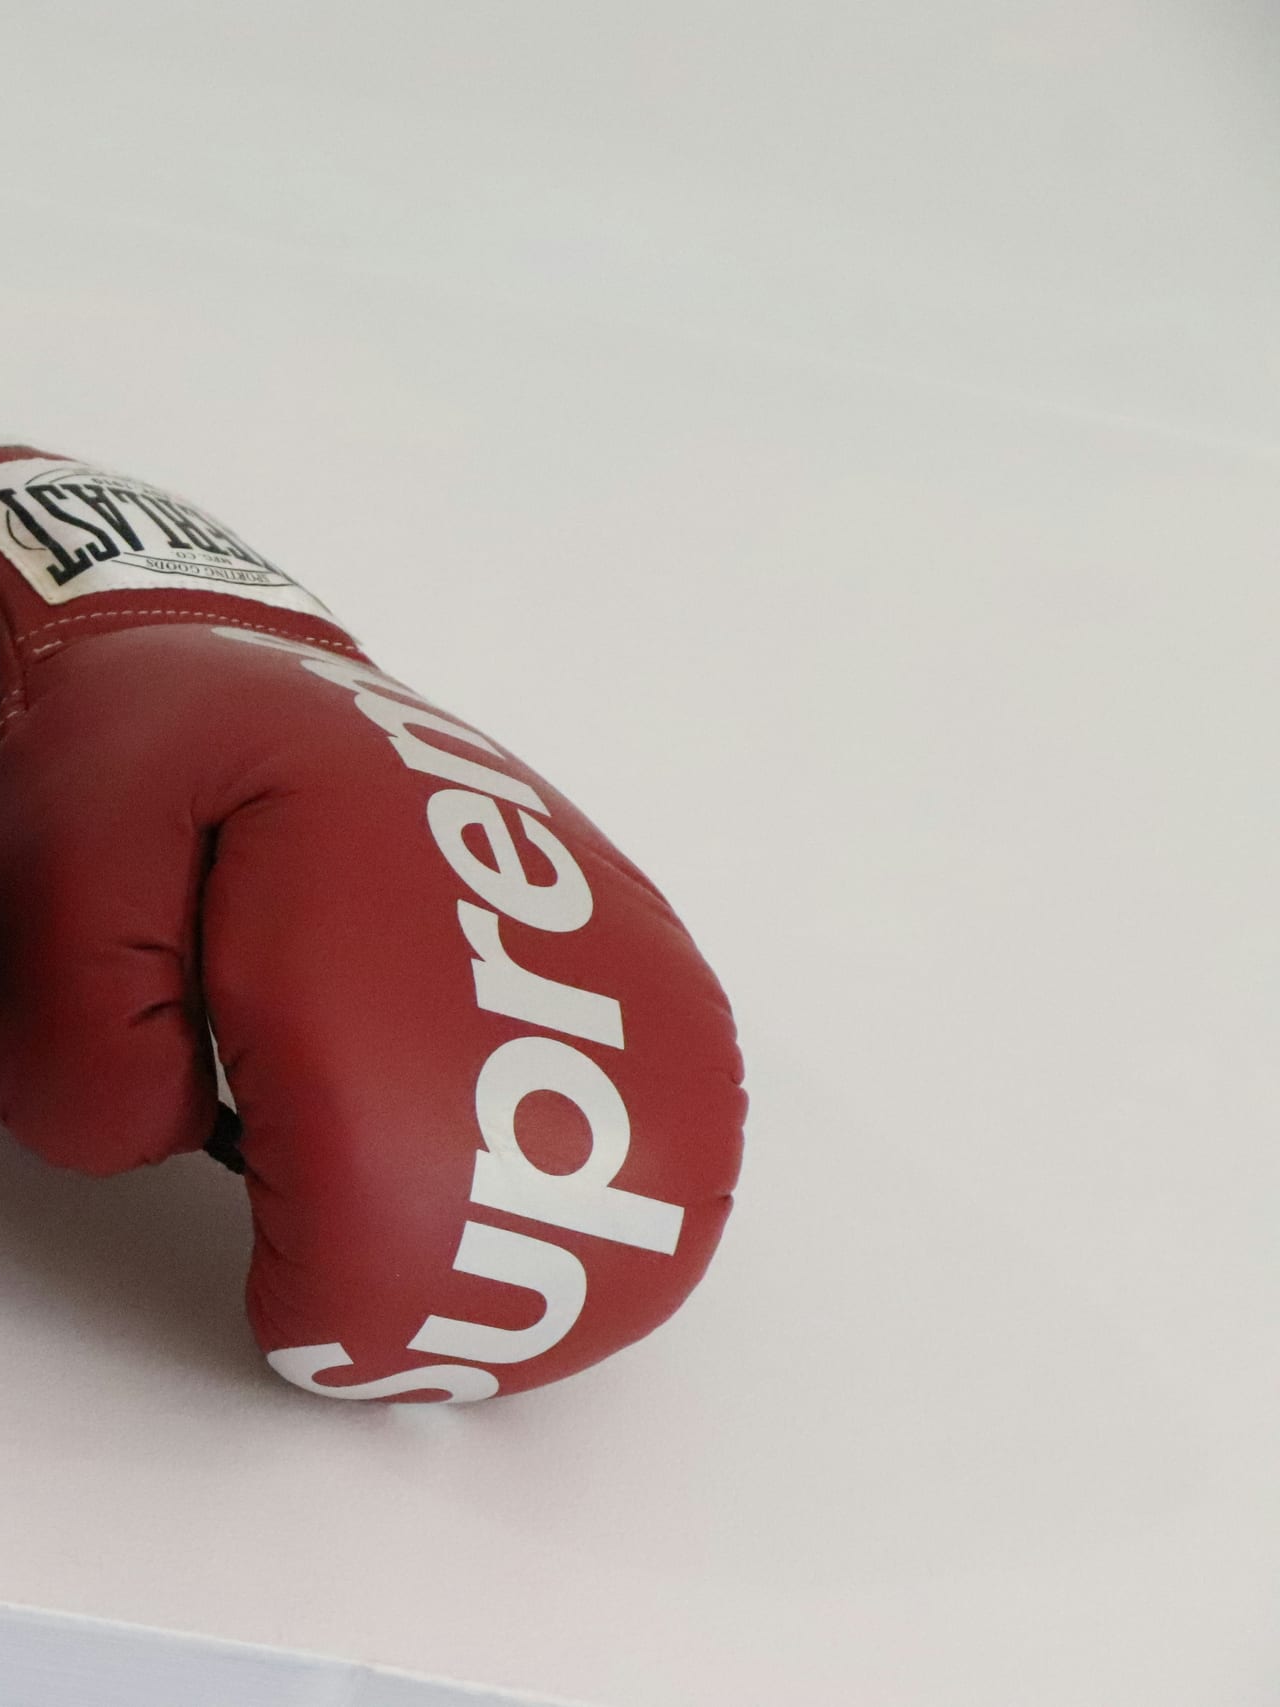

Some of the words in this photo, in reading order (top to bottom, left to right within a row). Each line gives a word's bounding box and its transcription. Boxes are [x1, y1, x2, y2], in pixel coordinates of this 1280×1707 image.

[146, 558, 200, 575] GOODS
[204, 552, 233, 565] MFG.
[204, 566, 271, 583] SPORTING
[211, 626, 685, 1404] Suprem
